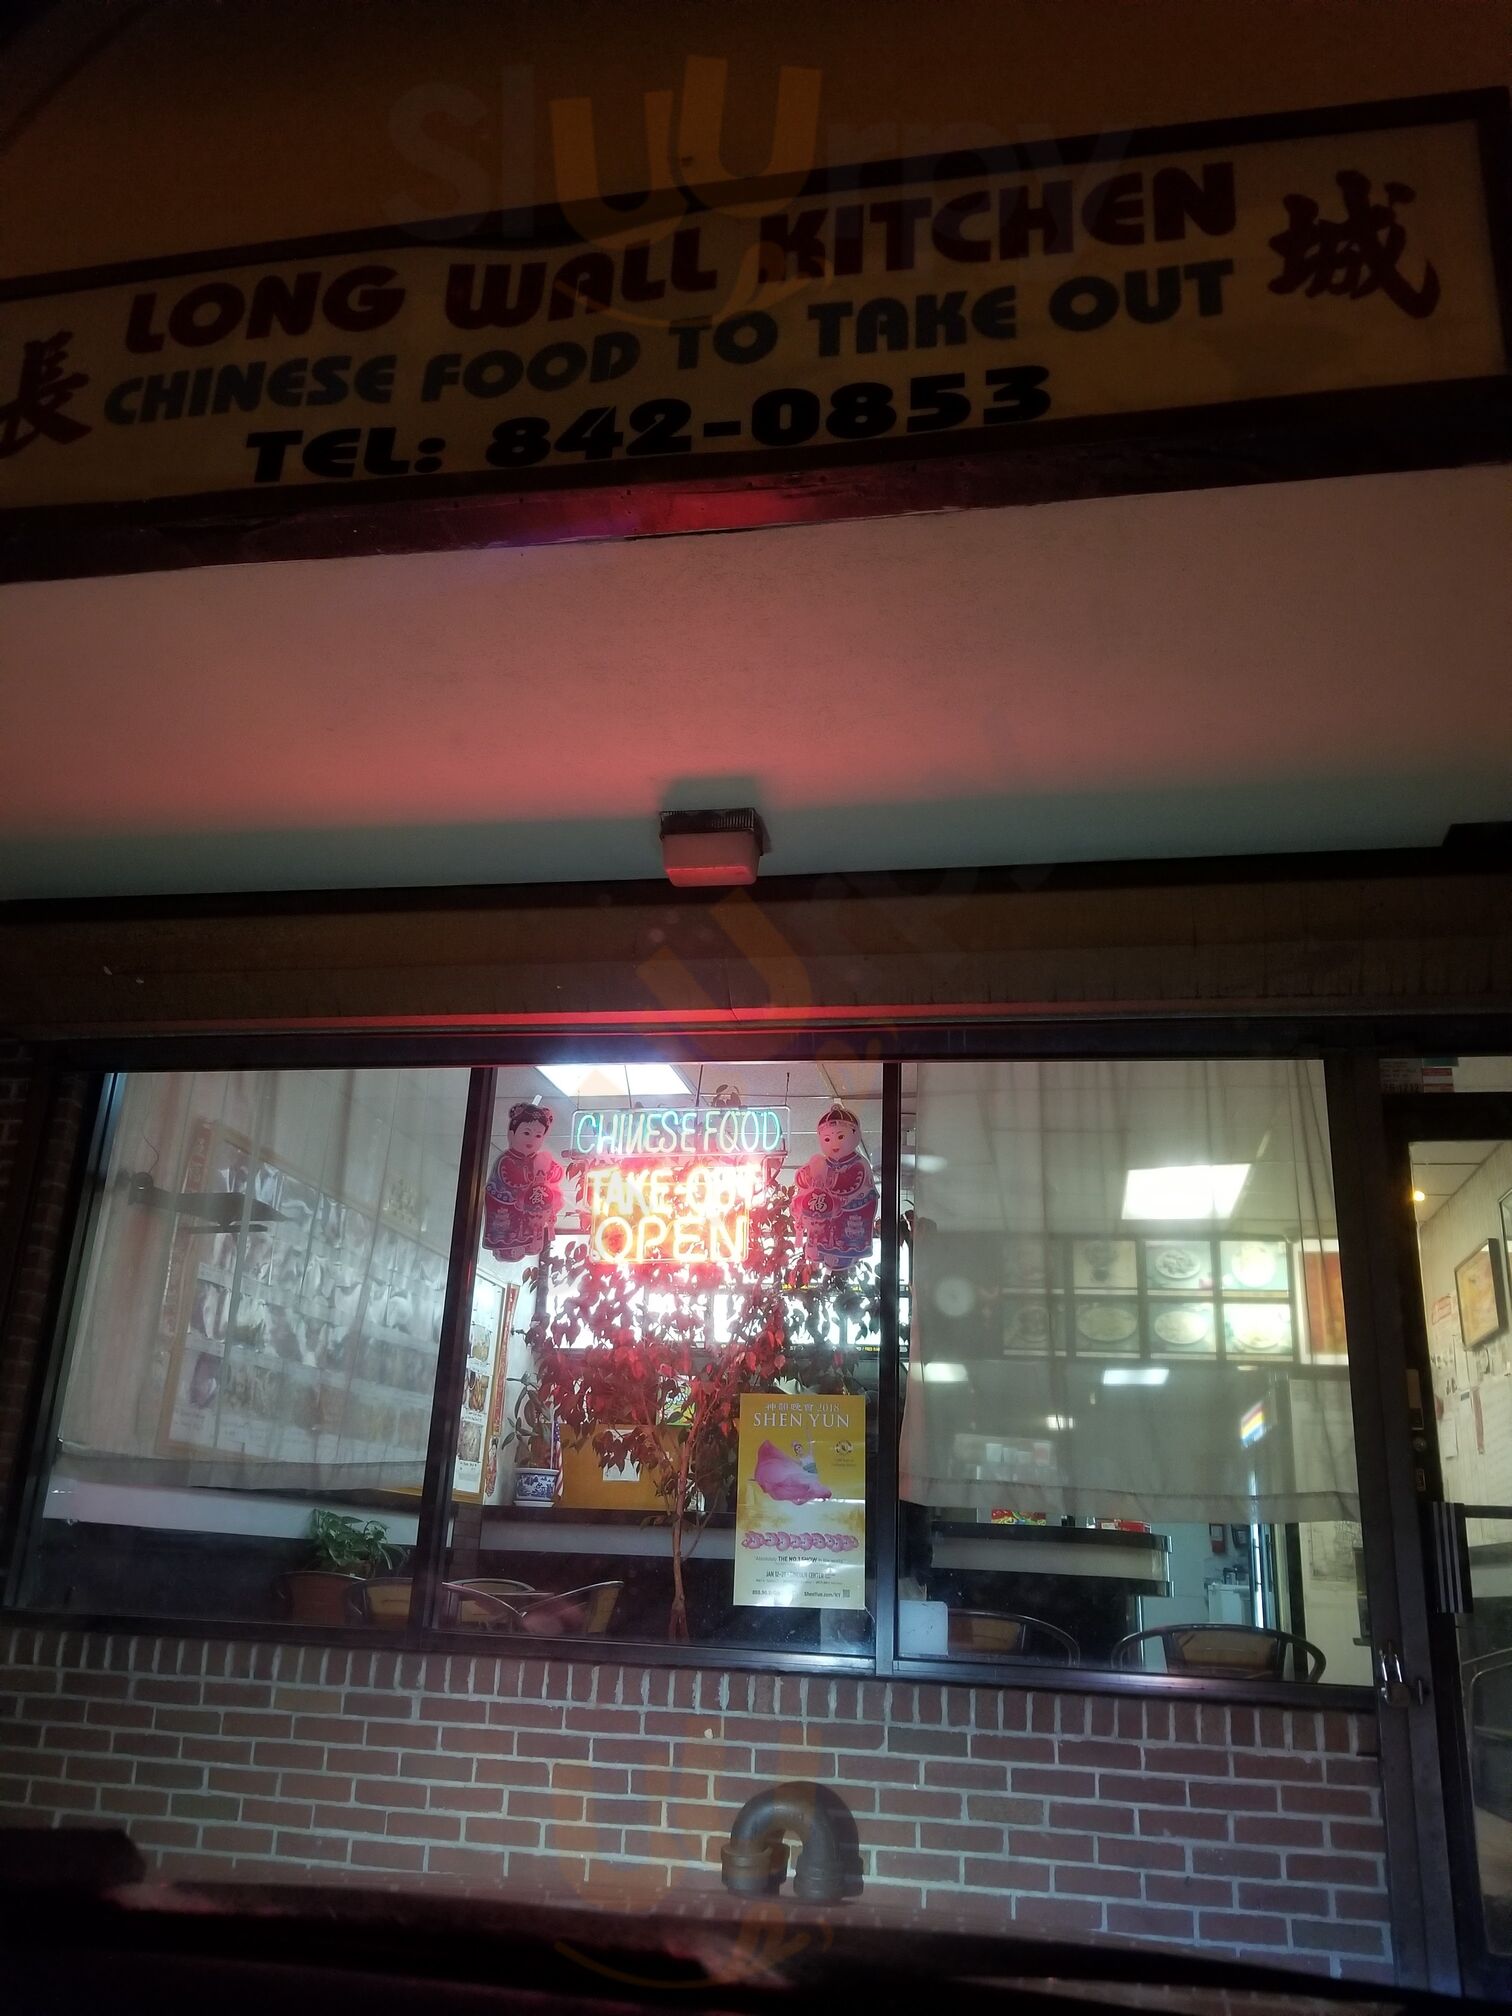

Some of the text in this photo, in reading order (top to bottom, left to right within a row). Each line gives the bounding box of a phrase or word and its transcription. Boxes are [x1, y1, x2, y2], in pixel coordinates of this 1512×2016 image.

[125, 161, 1238, 354] LONG WALL KITCHEN
[1267, 169, 1441, 319] 城
[0, 329, 93, 461] 長
[104, 259, 1235, 427] CHINESE FOOD TO TAKE OUT
[246, 365, 1052, 484] TEL: 842-0853
[574, 1110, 782, 1154] CHINESE FOOD
[594, 1216, 748, 1262] OPEN
[808, 1192, 828, 1212] 福
[753, 1412, 850, 1428] SHEN YUN
